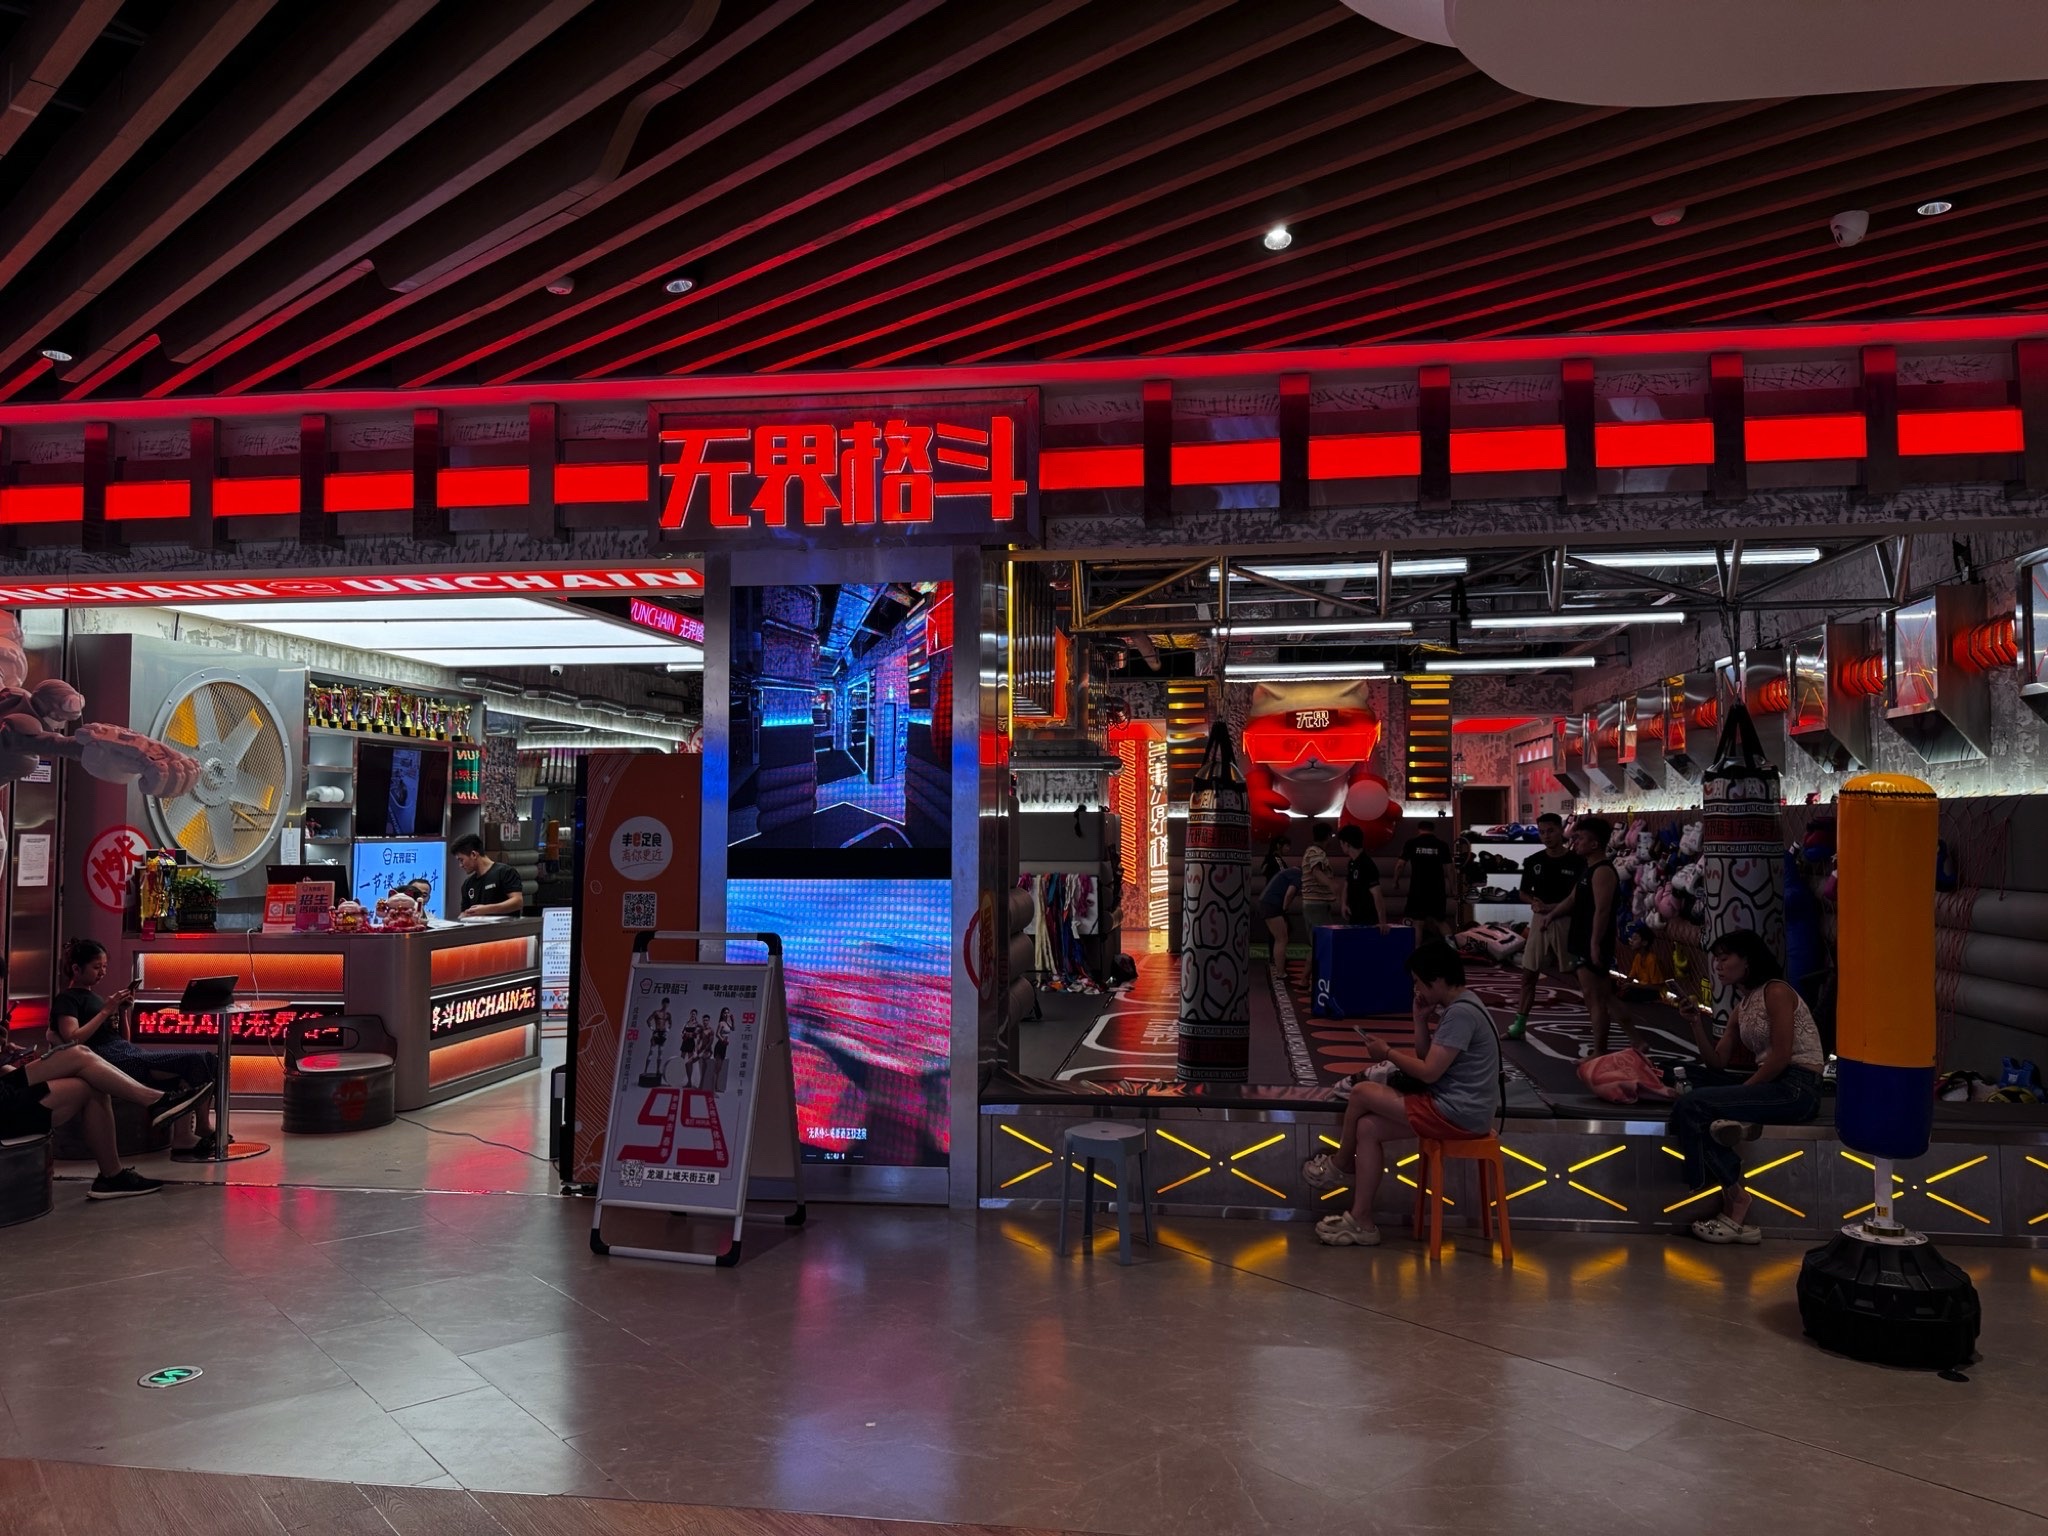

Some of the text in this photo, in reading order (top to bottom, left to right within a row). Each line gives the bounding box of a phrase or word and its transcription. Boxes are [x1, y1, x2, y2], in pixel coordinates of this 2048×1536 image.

[659, 416, 1027, 529] 无界格斗
[0, 571, 699, 600] NCHAIN UNCHAIN
[632, 602, 677, 632] UNCHAIN
[1296, 711, 1329, 728] 无界
[622, 849, 663, 862] 离你更近
[299, 894, 329, 905] 招生
[653, 982, 688, 995] 无界格斗
[617, 1088, 729, 1168] 99
[646, 1169, 716, 1184] 龙湖上城天街五楼
